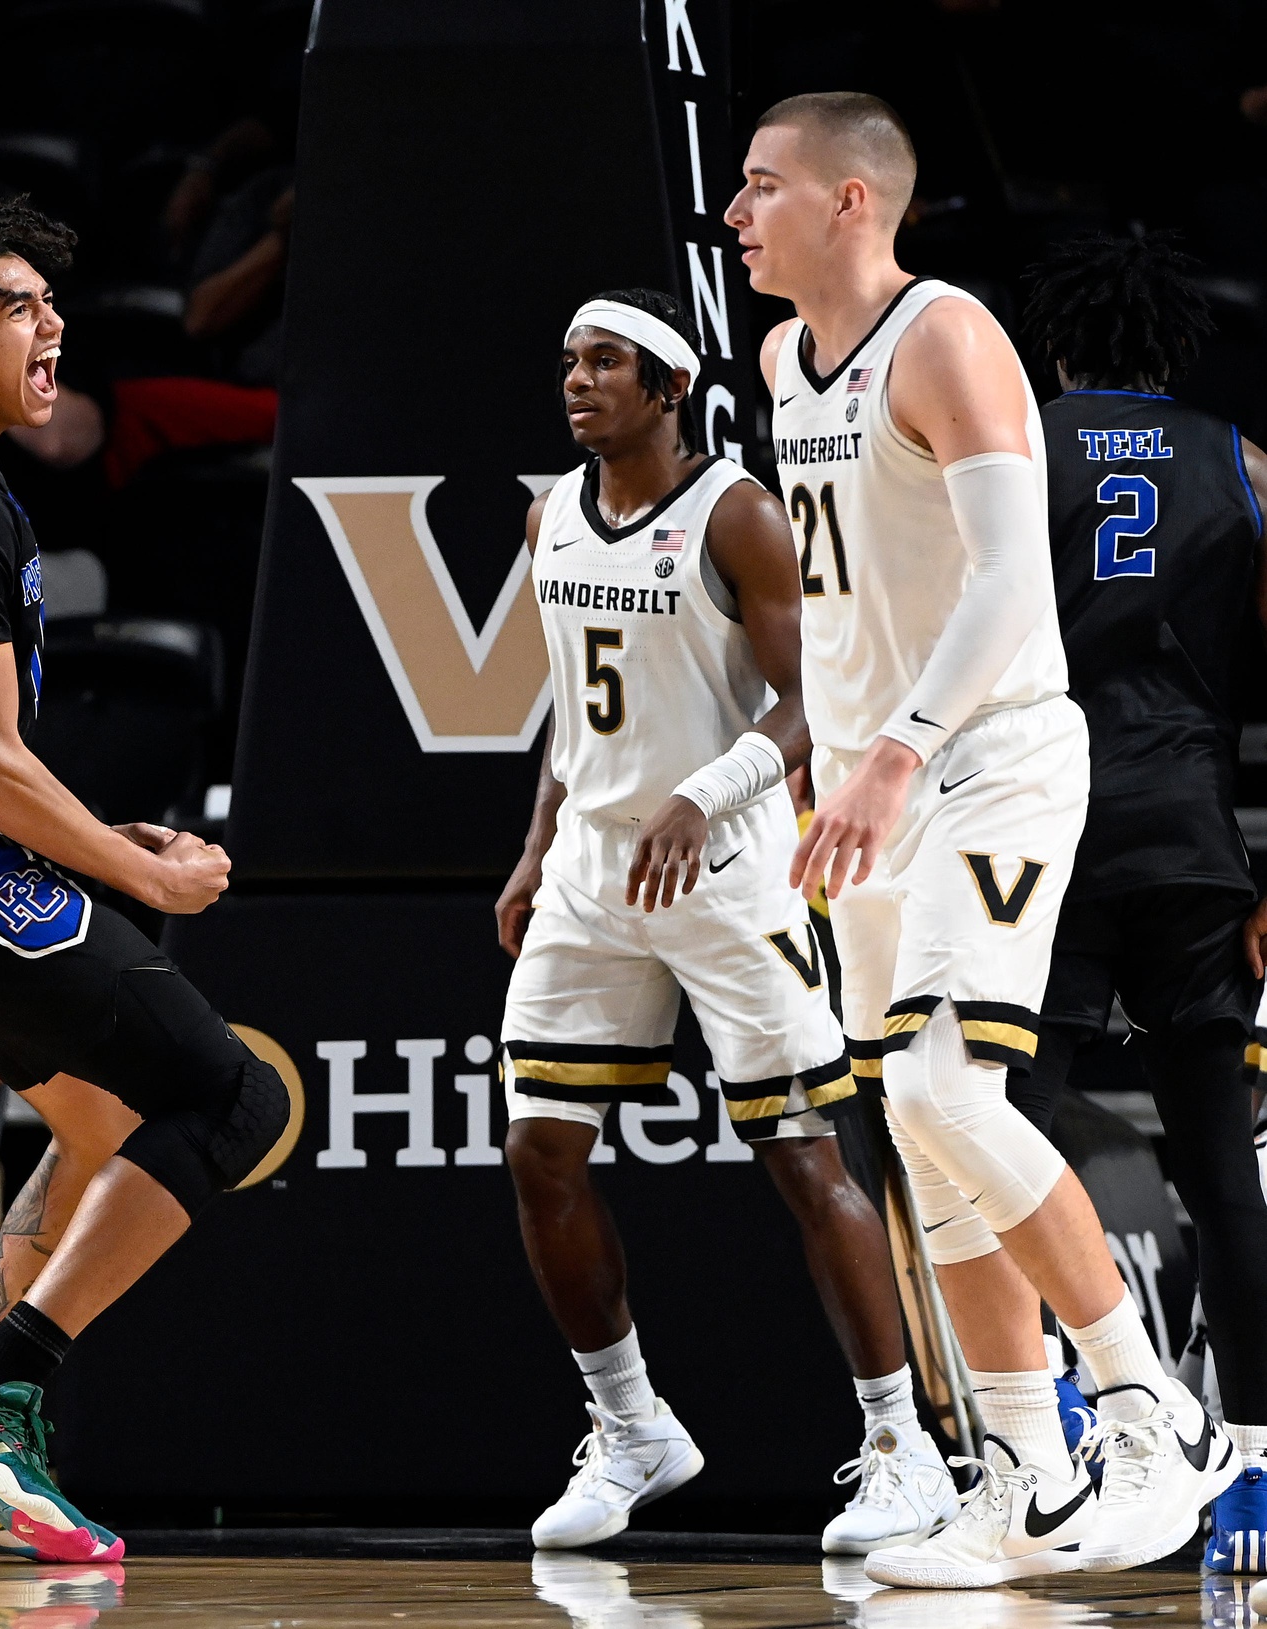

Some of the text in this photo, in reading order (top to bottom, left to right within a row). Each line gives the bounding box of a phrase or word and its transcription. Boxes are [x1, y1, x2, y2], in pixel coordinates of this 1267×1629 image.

[775, 433, 862, 465] VANDERBILT
[1077, 427, 1174, 462] TEEL
[791, 481, 852, 597] 21
[1094, 473, 1159, 581] 2
[539, 579, 681, 615] VANDERBILT
[655, 556, 675, 579] SEC
[291, 474, 563, 753] V
[584, 626, 626, 736] 5
[957, 850, 1050, 929] V
[760, 920, 824, 993] V
[316, 1033, 756, 1169] Hier
